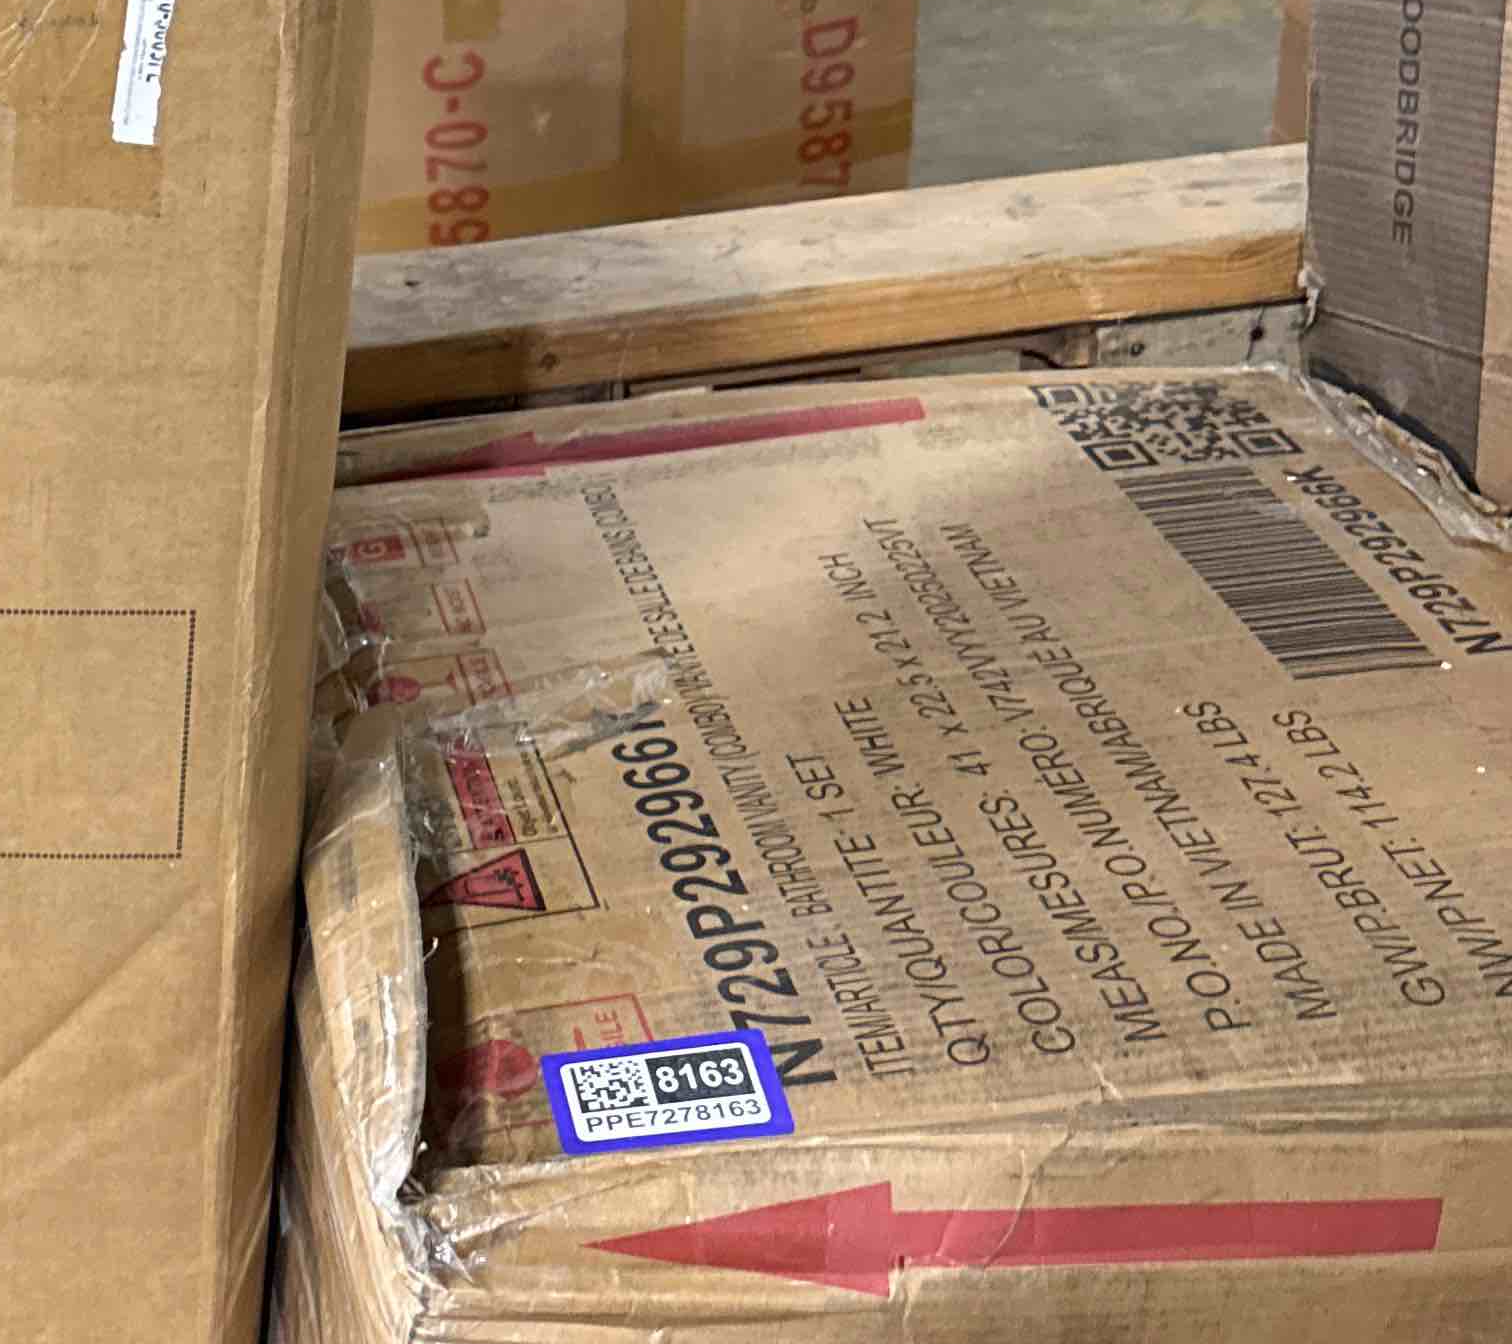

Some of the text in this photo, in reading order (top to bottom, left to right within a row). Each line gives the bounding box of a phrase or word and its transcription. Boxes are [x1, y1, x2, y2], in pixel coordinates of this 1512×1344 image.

[798, 14, 860, 193] D9587
[814, 550, 877, 602] INCH
[935, 520, 1034, 611] VIETNAM
[1284, 465, 1512, 656] N729P292966K
[854, 609, 913, 654] 21.2
[1001, 612, 1061, 646] AU
[895, 670, 958, 719] 22.5
[1266, 708, 1346, 758] LBS
[714, 759, 786, 821] VANITY
[784, 749, 846, 800] SET
[943, 747, 995, 779] 41
[1312, 760, 1405, 829] 114.2
[745, 819, 837, 918] BATHROOM
[831, 696, 1084, 1056] COLOR/COULEUR: WHITE
[1174, 698, 1459, 1007] GW/P.BRUT: 127.4 LBS
[971, 787, 1173, 1045] MEAS/MESURES:
[1203, 879, 1266, 912] IN
[1229, 916, 1348, 1022] MADE
[654, 1056, 745, 1094] 8163
[586, 1098, 762, 1134] PPE7278163
